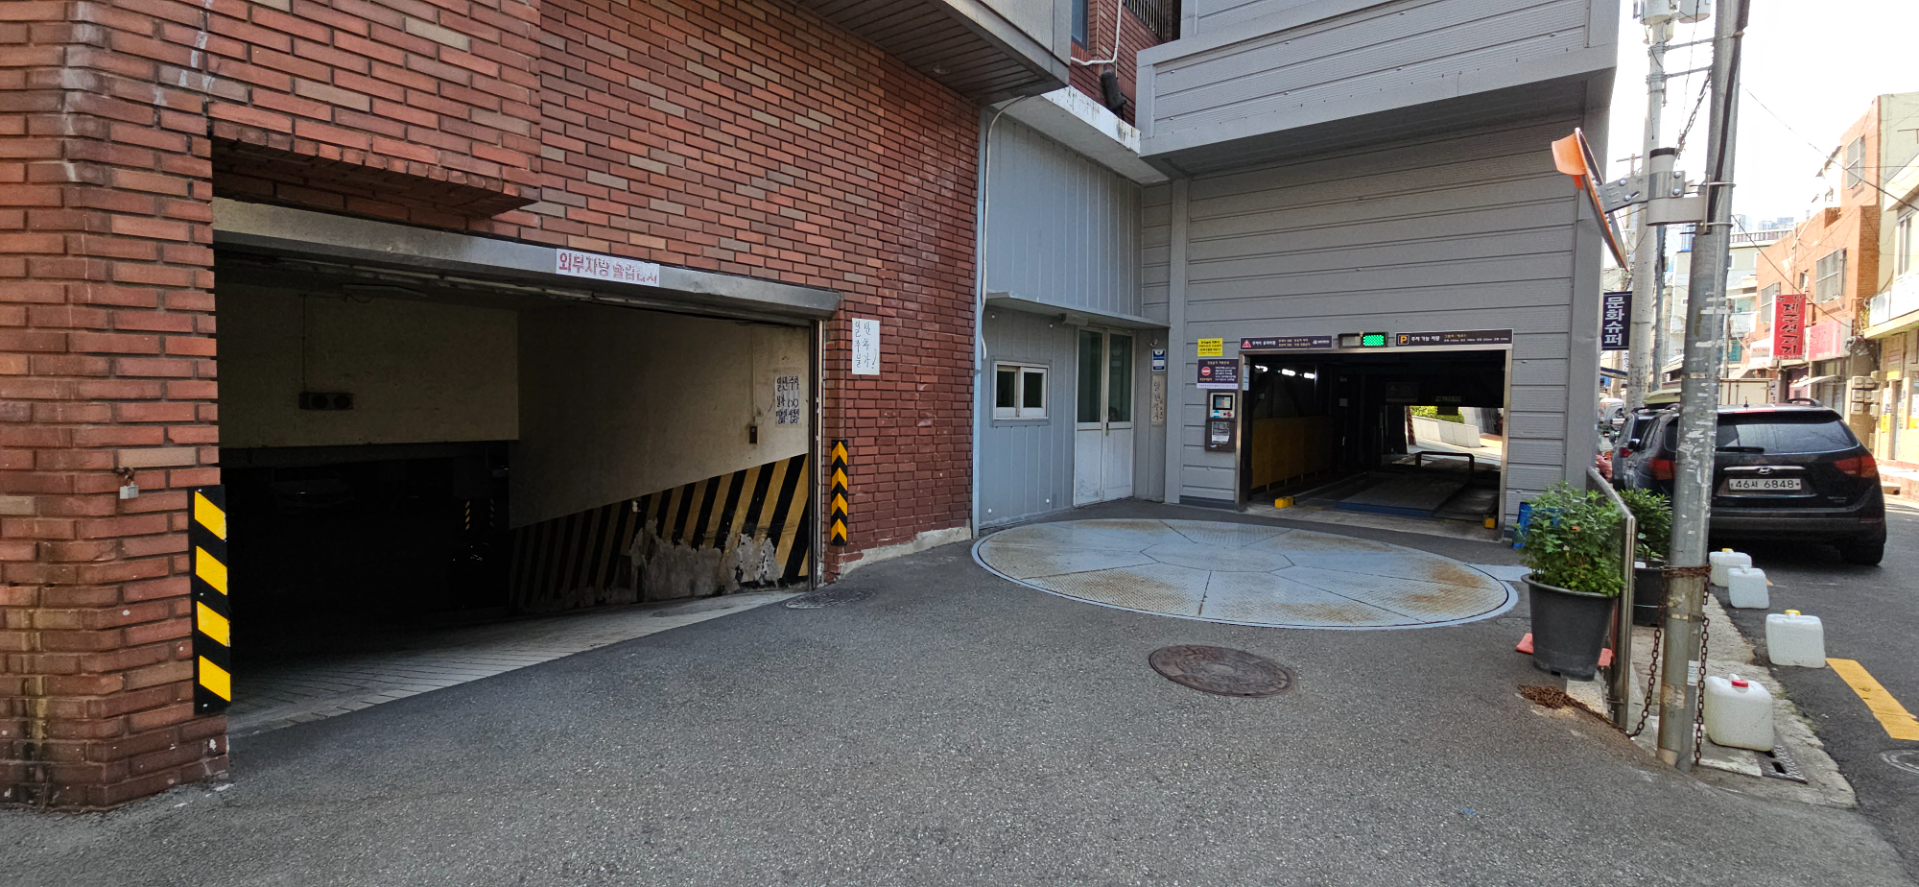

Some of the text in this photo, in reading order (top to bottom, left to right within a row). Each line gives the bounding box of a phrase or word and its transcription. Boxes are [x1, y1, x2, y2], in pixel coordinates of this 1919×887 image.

[1604, 296, 1625, 346] 문화슈퍼
[1780, 302, 1800, 354] 제주생고기
[1764, 480, 1795, 489] 6848
